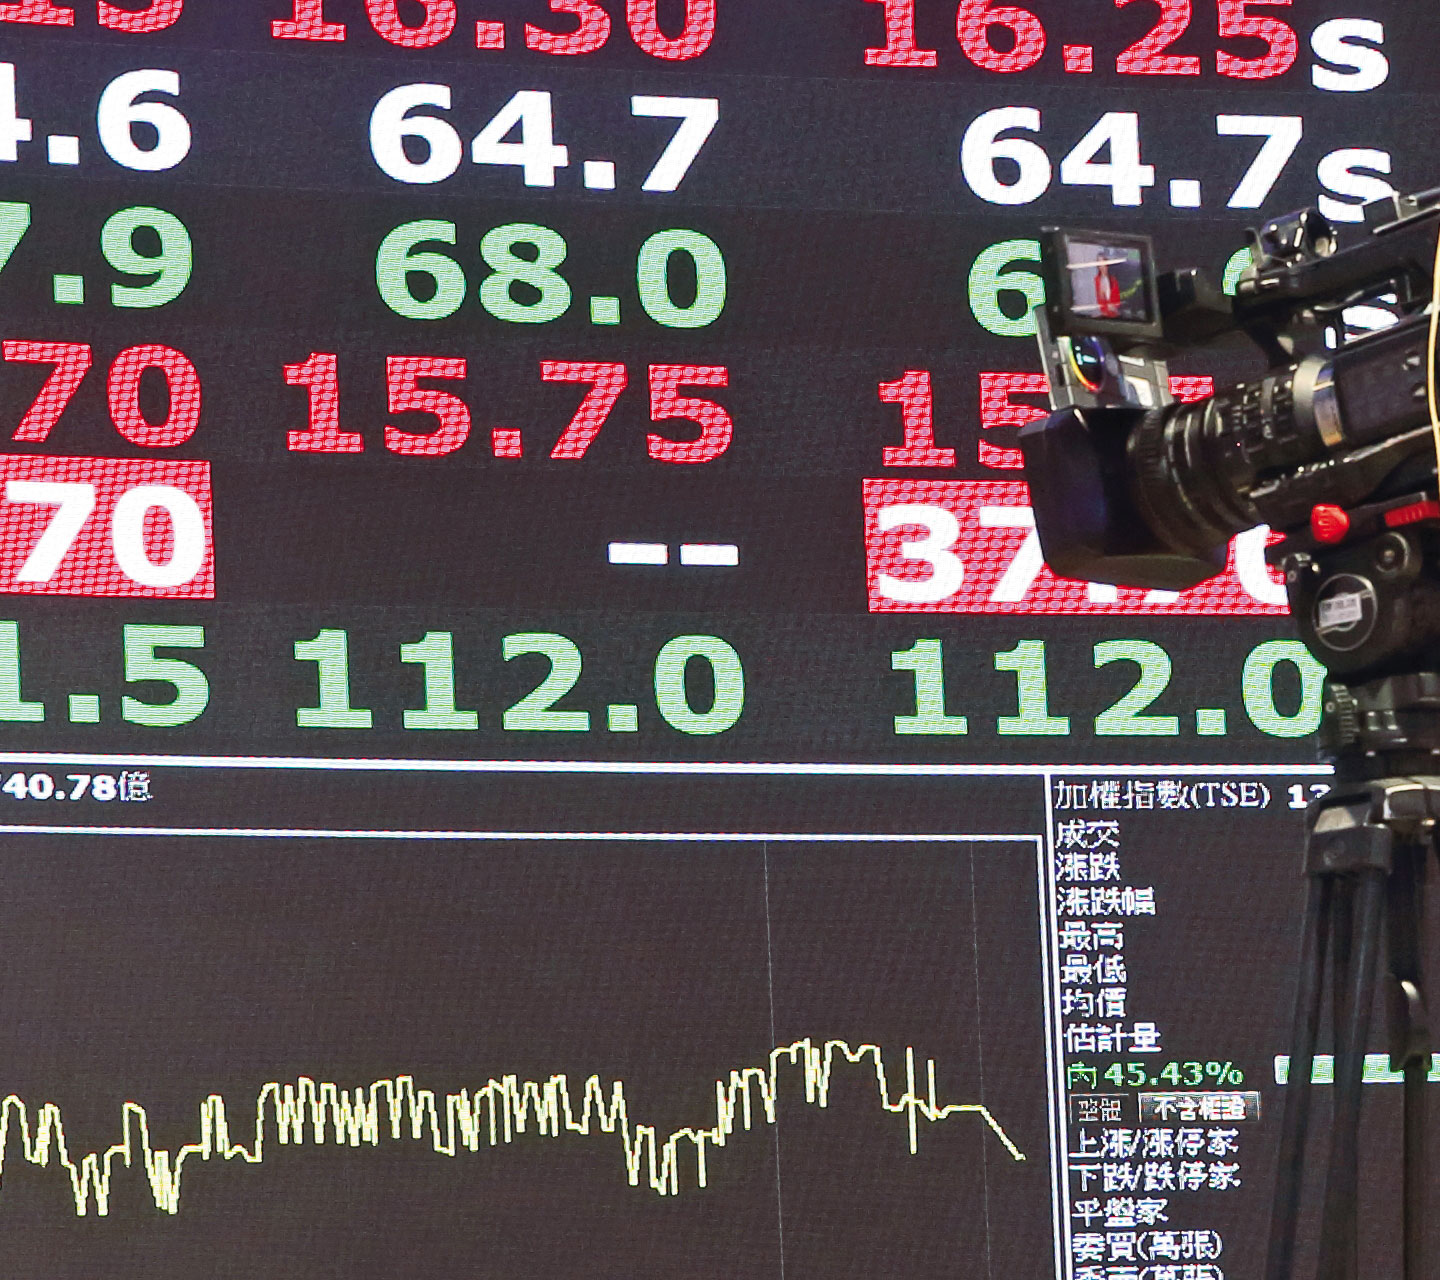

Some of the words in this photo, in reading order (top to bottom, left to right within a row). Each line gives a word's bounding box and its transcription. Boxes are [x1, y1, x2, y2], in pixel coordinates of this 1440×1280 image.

[370, 83, 718, 192] 64.7
[376, 220, 726, 328] 68.0
[283, 352, 733, 464] 15.75
[294, 629, 745, 734] 112.0
